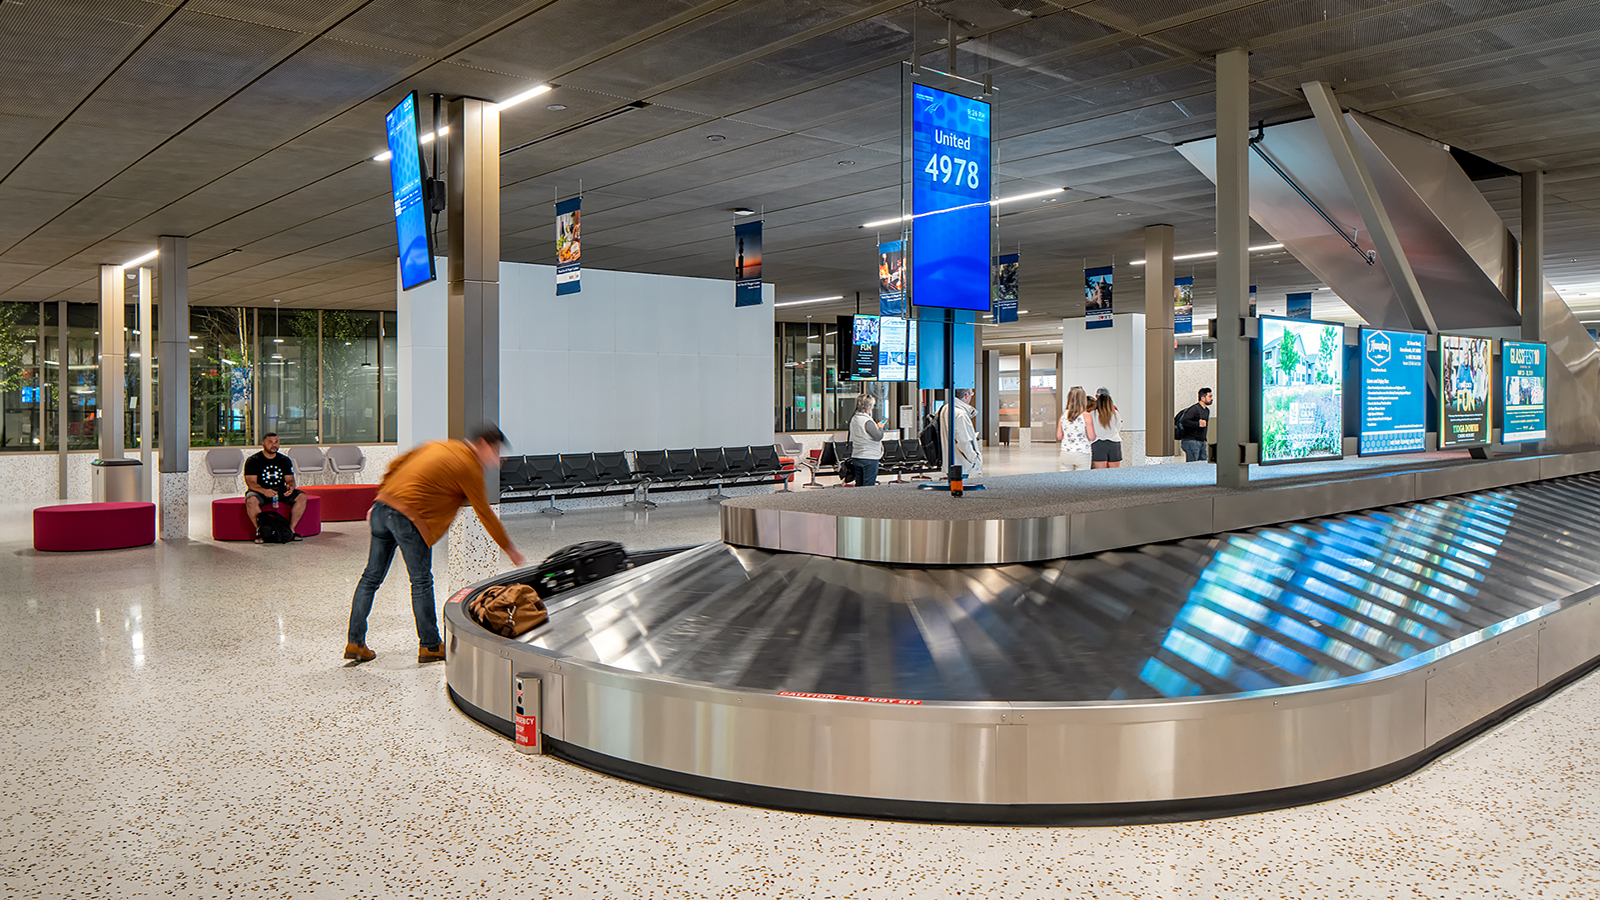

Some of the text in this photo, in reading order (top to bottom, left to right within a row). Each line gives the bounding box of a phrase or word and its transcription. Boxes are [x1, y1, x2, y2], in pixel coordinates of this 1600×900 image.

[935, 129, 971, 151] United
[925, 153, 979, 189] 4978
[1457, 389, 1476, 412] FUN
[780, 691, 836, 699] CAUTION
